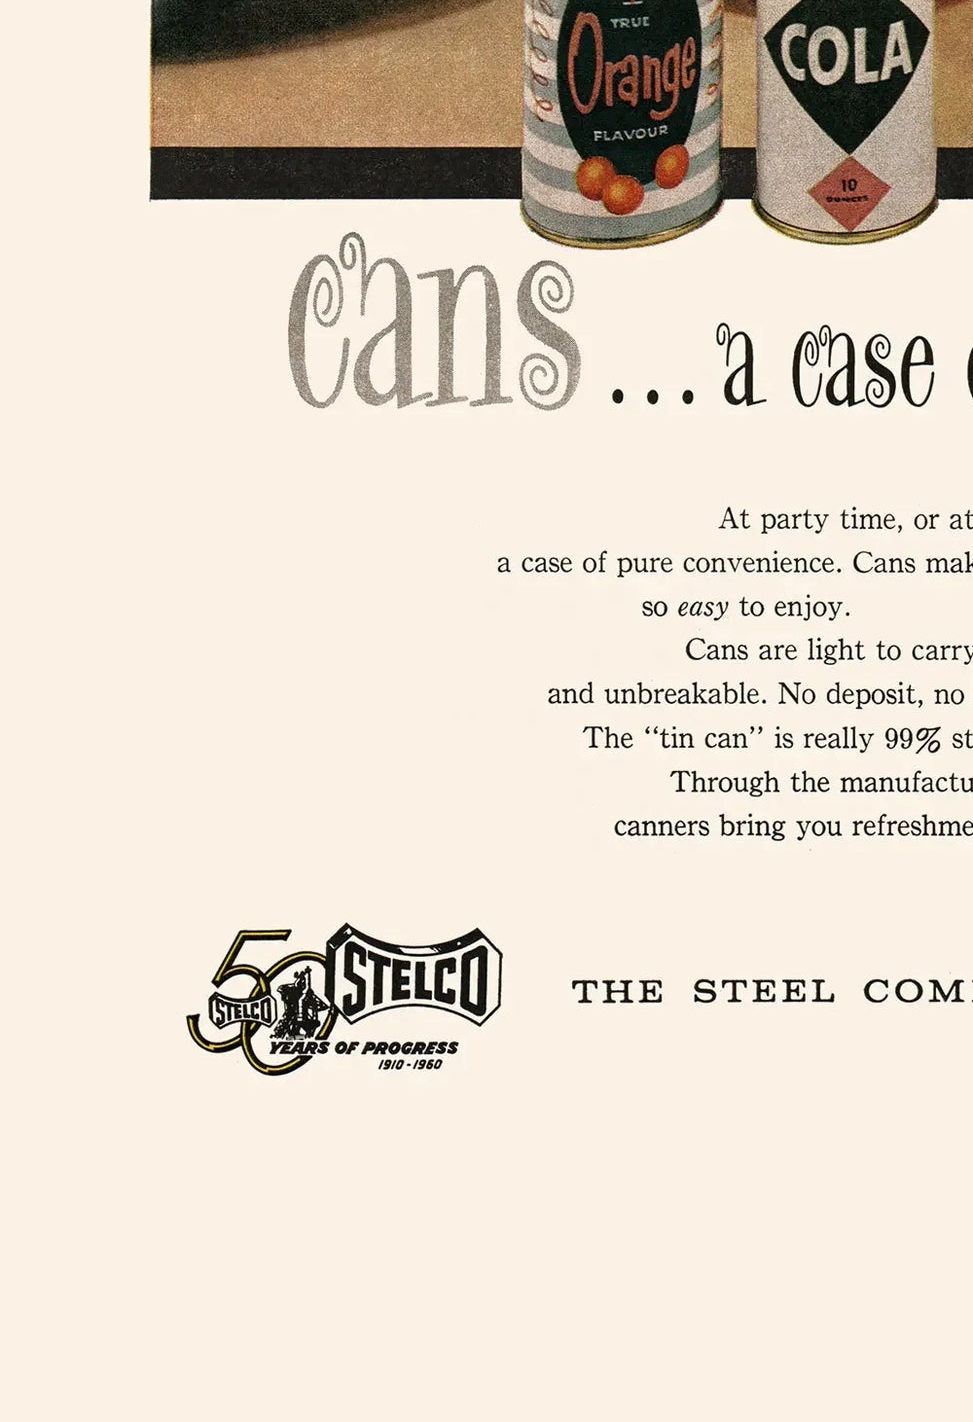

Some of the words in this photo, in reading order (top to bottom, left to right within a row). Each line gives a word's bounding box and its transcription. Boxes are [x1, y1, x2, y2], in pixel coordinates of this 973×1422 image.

[610, 16, 650, 30] TRUE
[568, 12, 697, 122] Orange
[780, 20, 914, 86] COLA
[593, 124, 669, 142] FLAVOUR
[841, 178, 858, 192] 10
[288, 233, 582, 411] cans
[716, 323, 768, 407] a
[792, 325, 935, 408] case
[718, 506, 751, 530] At
[760, 509, 830, 535] party
[840, 506, 903, 534] time,
[913, 513, 940, 531] or
[497, 556, 512, 573] a
[521, 556, 573, 574] case
[582, 550, 608, 574] of
[616, 556, 674, 578] pure
[683, 550, 842, 574] convenience.
[852, 550, 916, 574] Cans
[641, 600, 668, 618] so
[677, 600, 729, 622] easy
[738, 596, 765, 617] to
[774, 593, 850, 622] enjoy.
[685, 637, 749, 661] Cans
[758, 644, 798, 661] are
[807, 637, 866, 666] light
[876, 640, 902, 661] to
[547, 681, 595, 705] and
[604, 681, 767, 705] unbreakable.
[778, 681, 817, 705] No
[826, 681, 924, 710] deposit,
[933, 688, 965, 706] no
[582, 725, 634, 749] The
[774, 725, 794, 749] is
[803, 725, 875, 754] really
[884, 726, 942, 755] 99%
[669, 770, 781, 798] Through
[790, 770, 831, 793] the
[614, 819, 710, 837] canners
[718, 813, 787, 842] bring
[795, 820, 843, 842] you
[343, 940, 489, 1017] STELCO
[571, 979, 663, 1004] THE
[693, 978, 835, 1004] STEEL
[214, 996, 273, 1028] STELCO
[269, 1040, 330, 1056] YEARS
[334, 1041, 358, 1055] OF
[361, 1041, 459, 1055] PROGRESS
